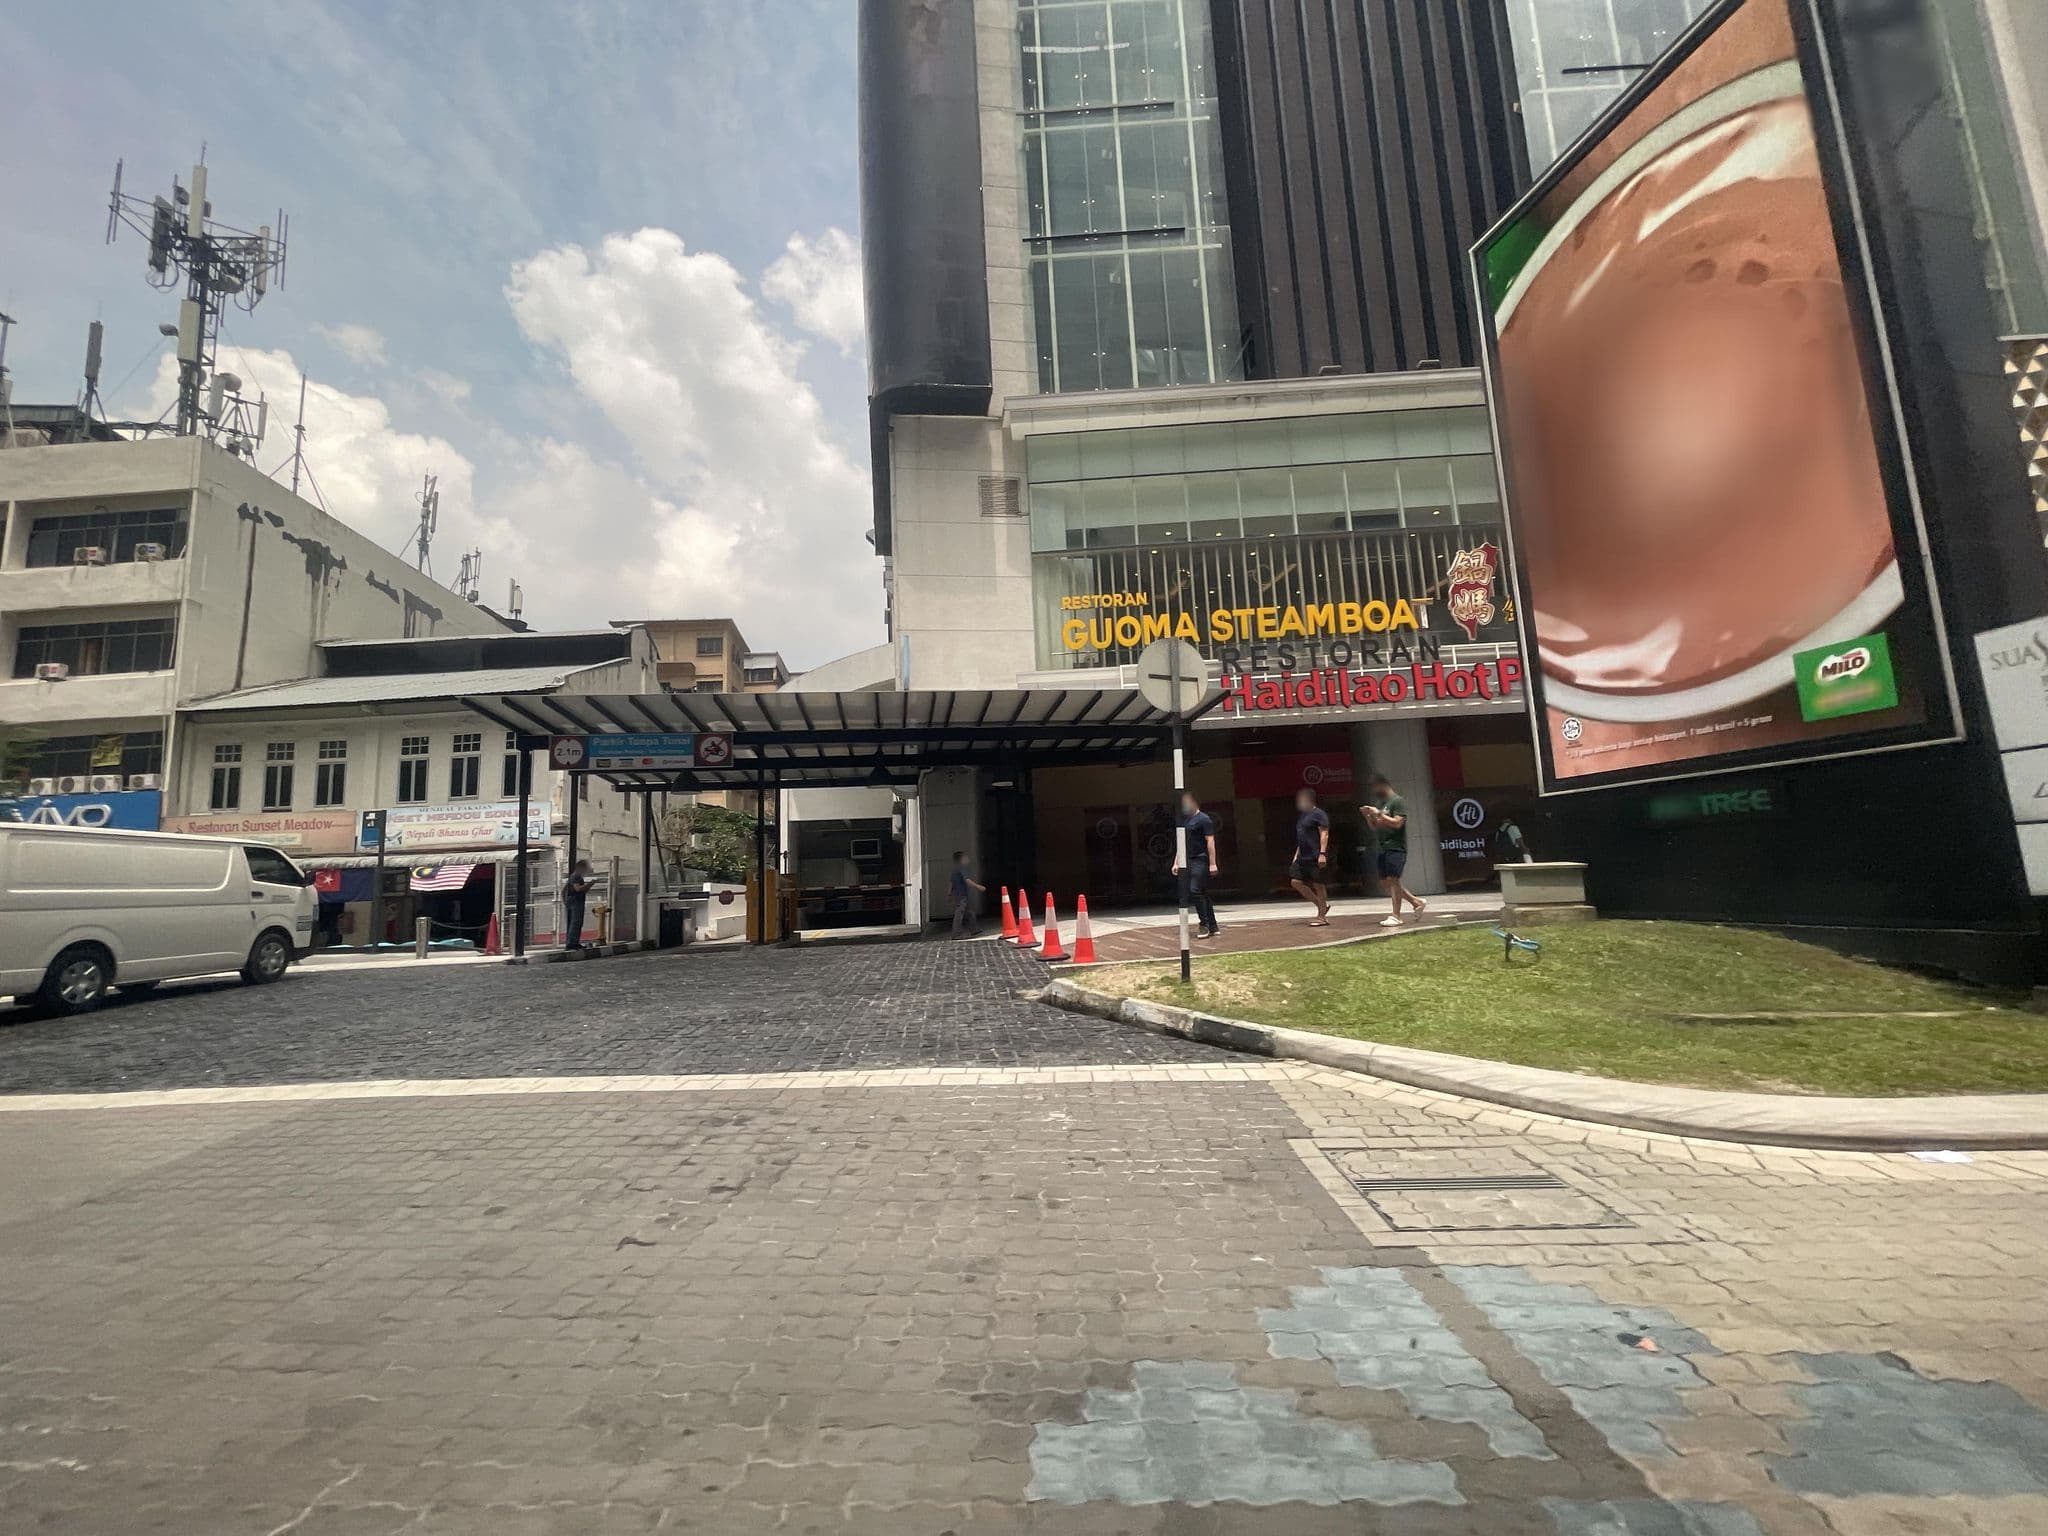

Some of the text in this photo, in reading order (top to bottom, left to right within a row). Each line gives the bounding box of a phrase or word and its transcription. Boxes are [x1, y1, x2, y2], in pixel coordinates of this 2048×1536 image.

[1061, 592, 1148, 609] RESTORAN
[1061, 597, 1433, 650] GUOMA STEAMBOAT
[1221, 634, 1440, 673] RESTORAN
[1821, 655, 1866, 677] MILO
[1221, 667, 1408, 711] Haidilao
[1412, 662, 1493, 701] Hot
[556, 748, 581, 757] 2.1m
[188, 818, 333, 834] Restoran Sunset Meadow
[405, 828, 436, 840] Nepali
[471, 826, 495, 837] Ghar
